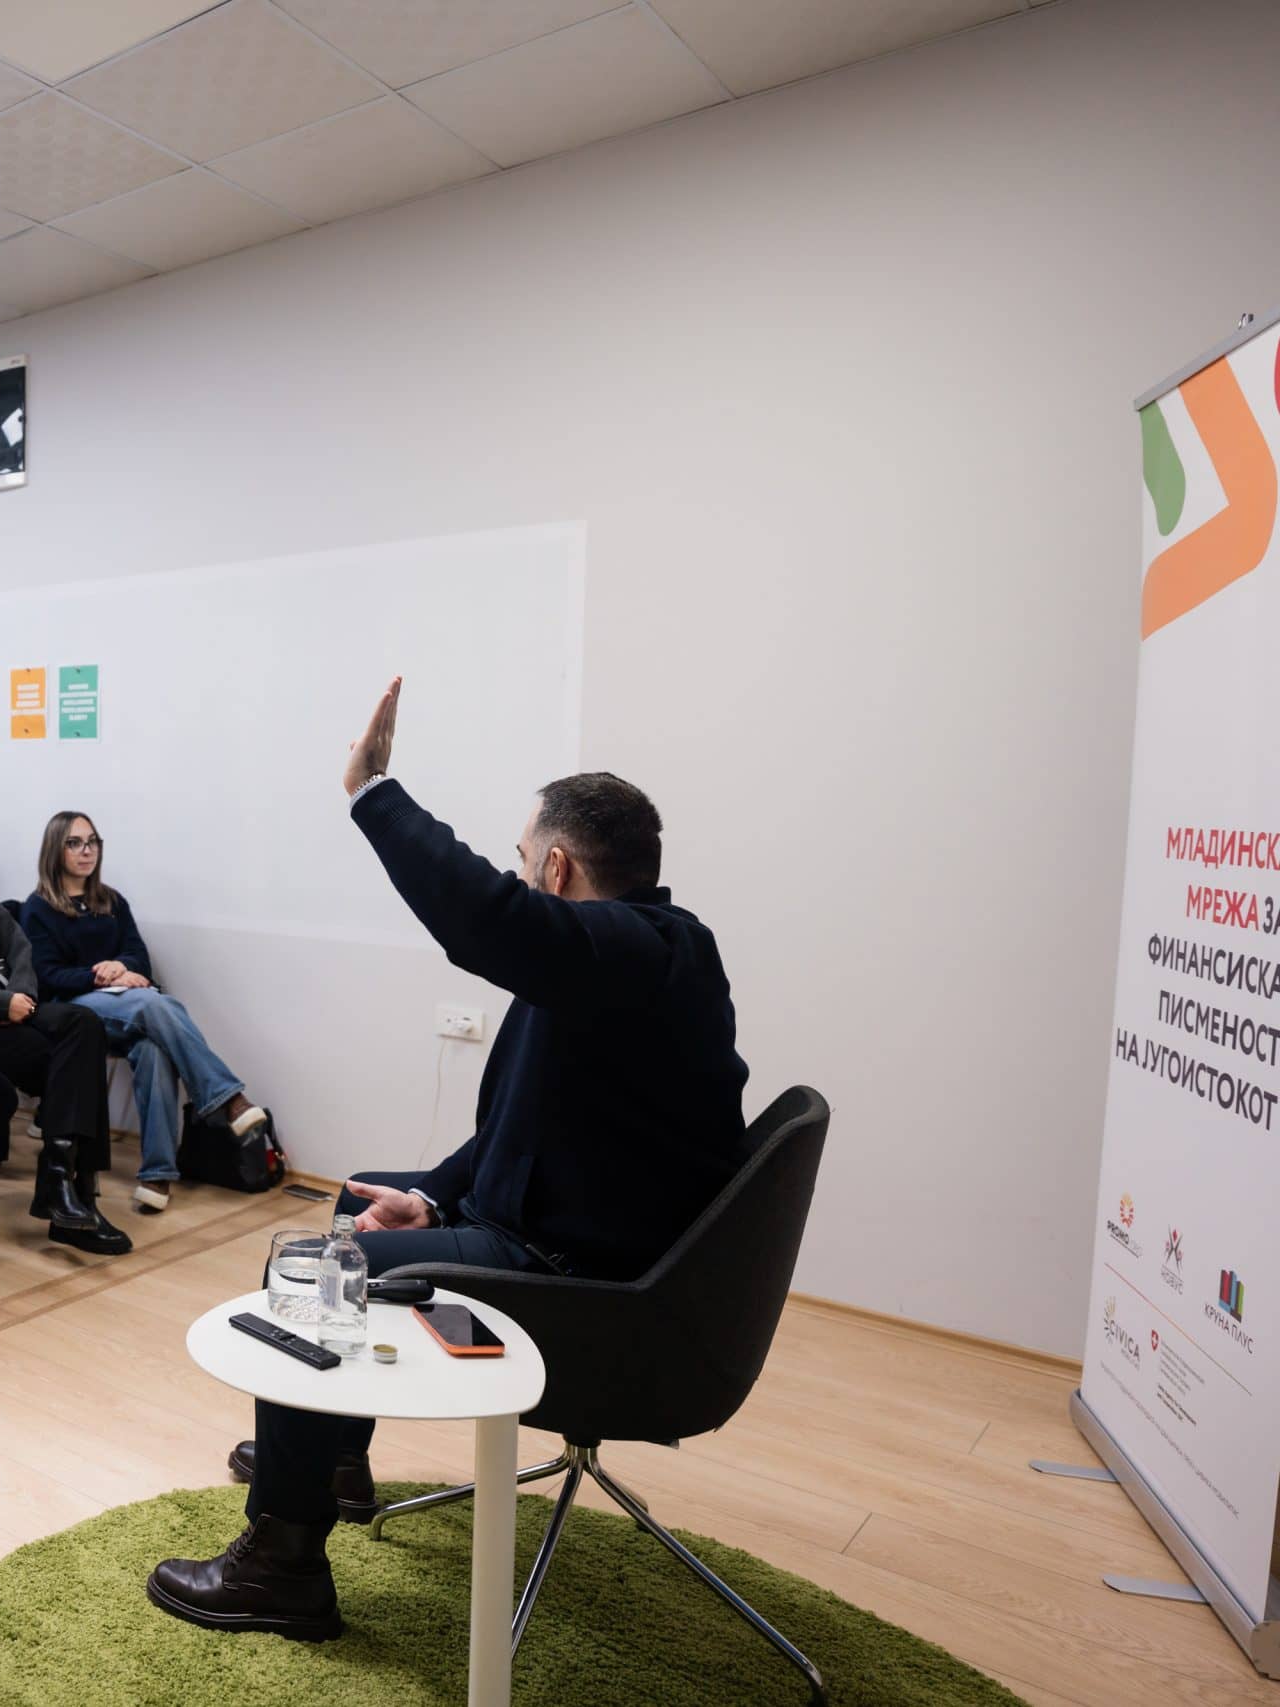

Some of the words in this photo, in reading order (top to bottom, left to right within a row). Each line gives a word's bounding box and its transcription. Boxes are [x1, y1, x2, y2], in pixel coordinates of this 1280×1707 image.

[1166, 826, 1280, 871] МЛАДИНСК
[1186, 884, 1260, 932] МРЕЖА
[1157, 990, 1280, 1067] ПИСМЕНОСТ
[1116, 1027, 1140, 1067] НА
[1142, 1038, 1278, 1132] ЈУГОИСТОКОТ
[1109, 1318, 1141, 1362] CIVICA
[1204, 1302, 1230, 1336] КРУНА
[1229, 1320, 1255, 1355] ПЛУС
